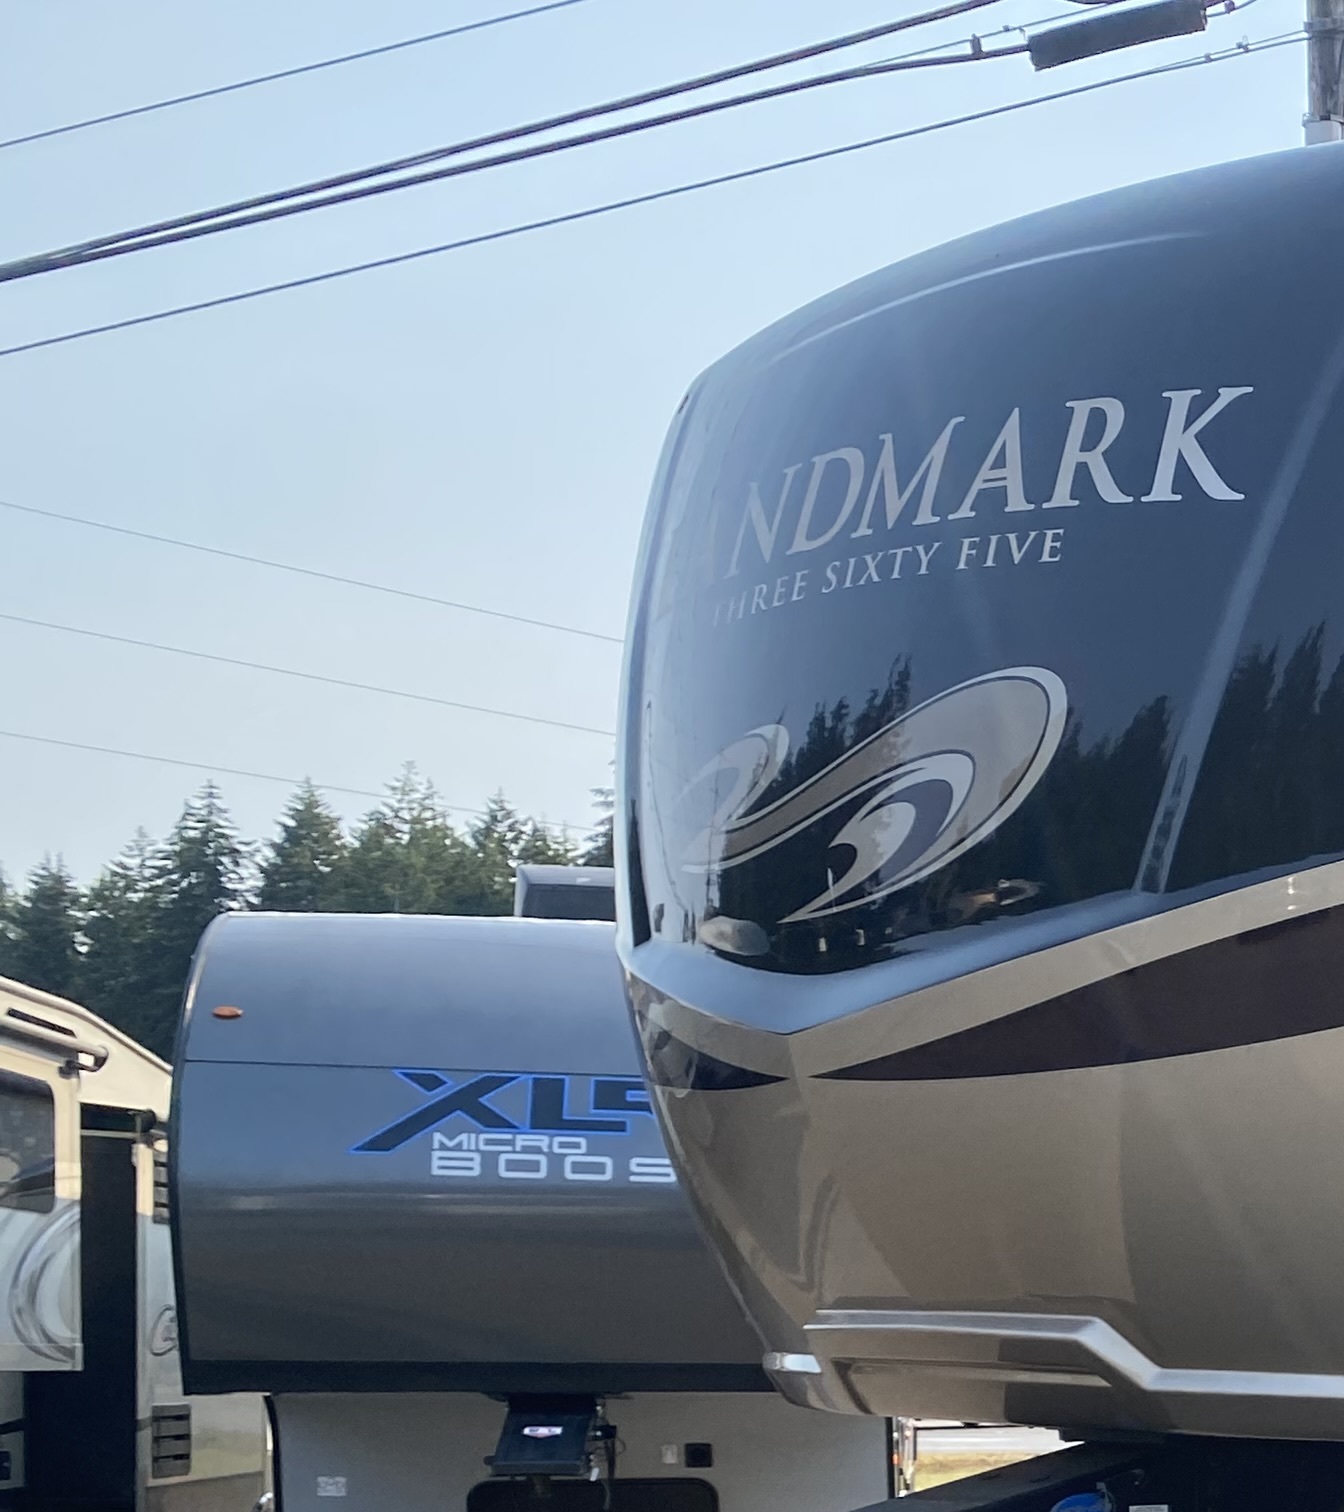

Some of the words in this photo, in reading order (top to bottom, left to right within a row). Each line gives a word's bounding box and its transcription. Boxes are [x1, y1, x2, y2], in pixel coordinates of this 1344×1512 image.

[708, 385, 1255, 583] NDMARK
[820, 541, 943, 595] SIXTY
[955, 528, 1065, 570] FIVE
[430, 1150, 679, 1183] BOOS
[431, 1131, 588, 1155] MICRO
